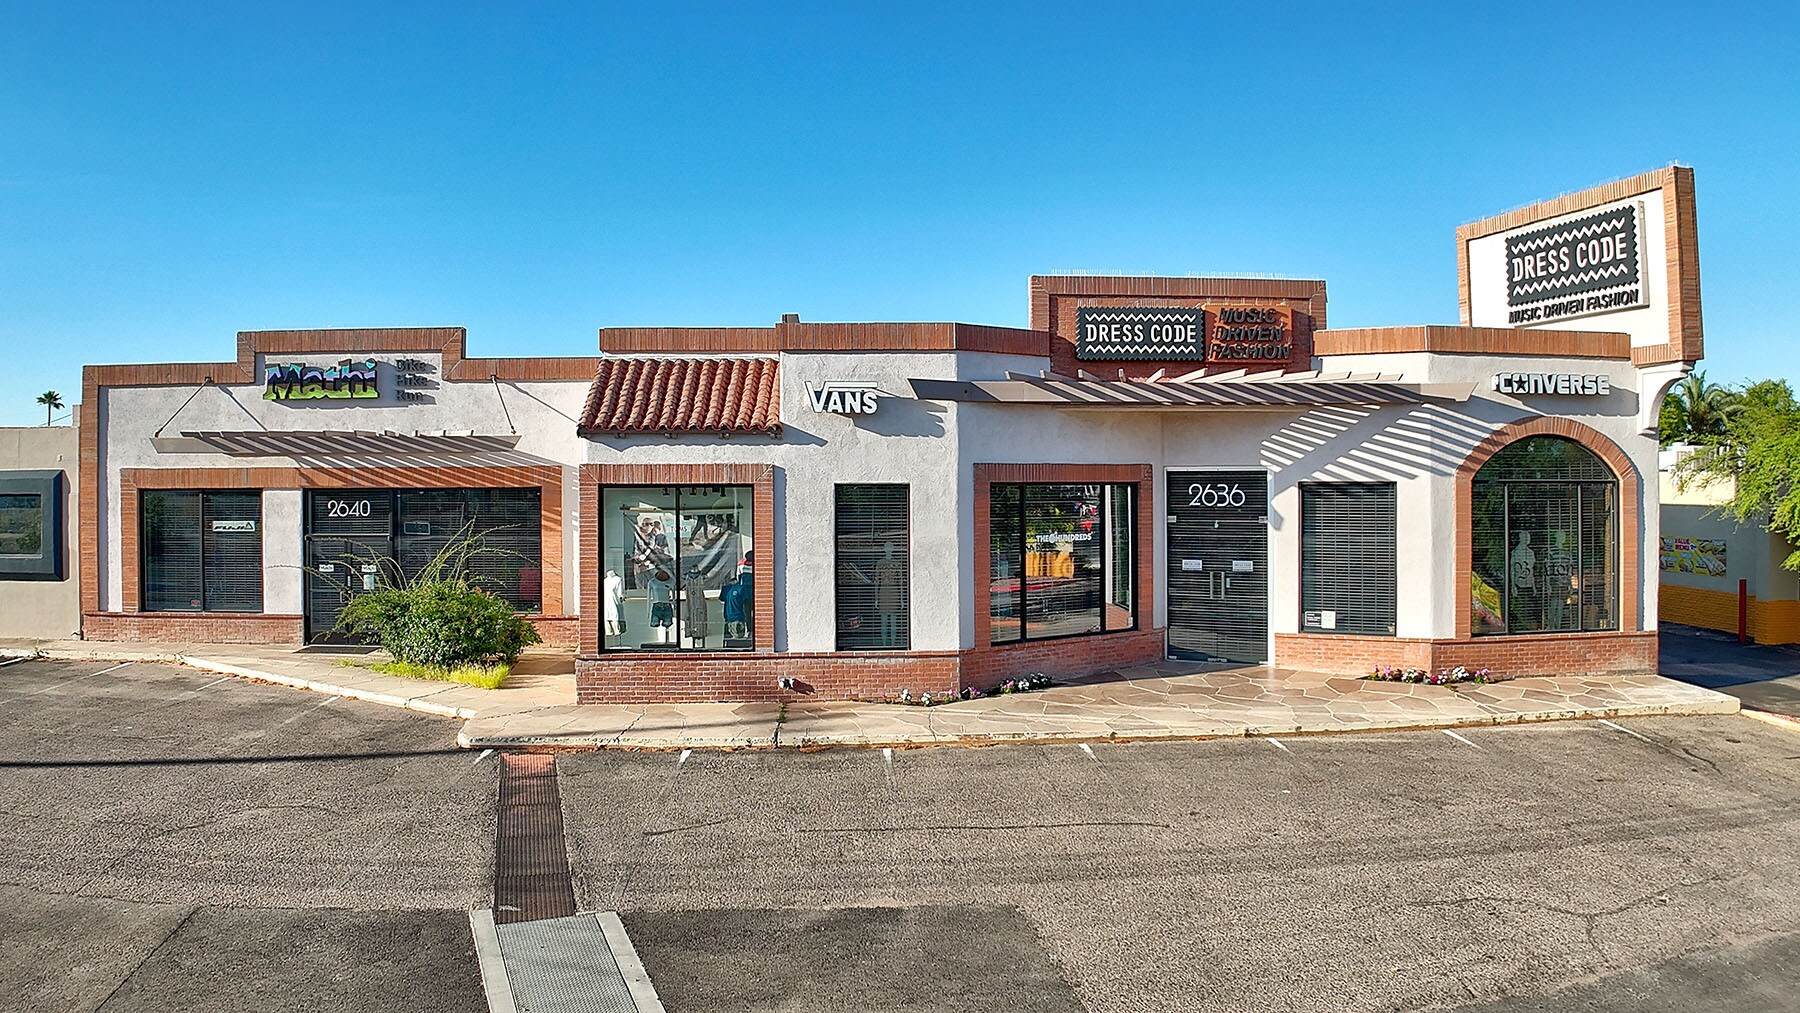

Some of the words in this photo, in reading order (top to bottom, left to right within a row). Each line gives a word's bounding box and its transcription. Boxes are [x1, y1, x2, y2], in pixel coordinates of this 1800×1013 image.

[1511, 246, 1570, 282] DRESS
[1576, 232, 1628, 268] CODE
[1508, 307, 1542, 323] MUSIC
[1543, 298, 1585, 318] DRIVEN
[1586, 288, 1639, 311] FASHION
[1218, 307, 1277, 324] MUSIC
[1085, 323, 1144, 343] DRESS
[1150, 324, 1197, 343] CODE
[1213, 325, 1285, 342] DRIVEN
[1207, 342, 1292, 361] FASHION
[395, 359, 427, 372] Bike
[1498, 372, 1611, 396] CONVERSE
[804, 381, 878, 415] VANS
[1188, 483, 1246, 507] 2636
[327, 499, 371, 517] 2640
[1036, 534, 1049, 543] THE
[1055, 533, 1092, 542] HUNDREDS
